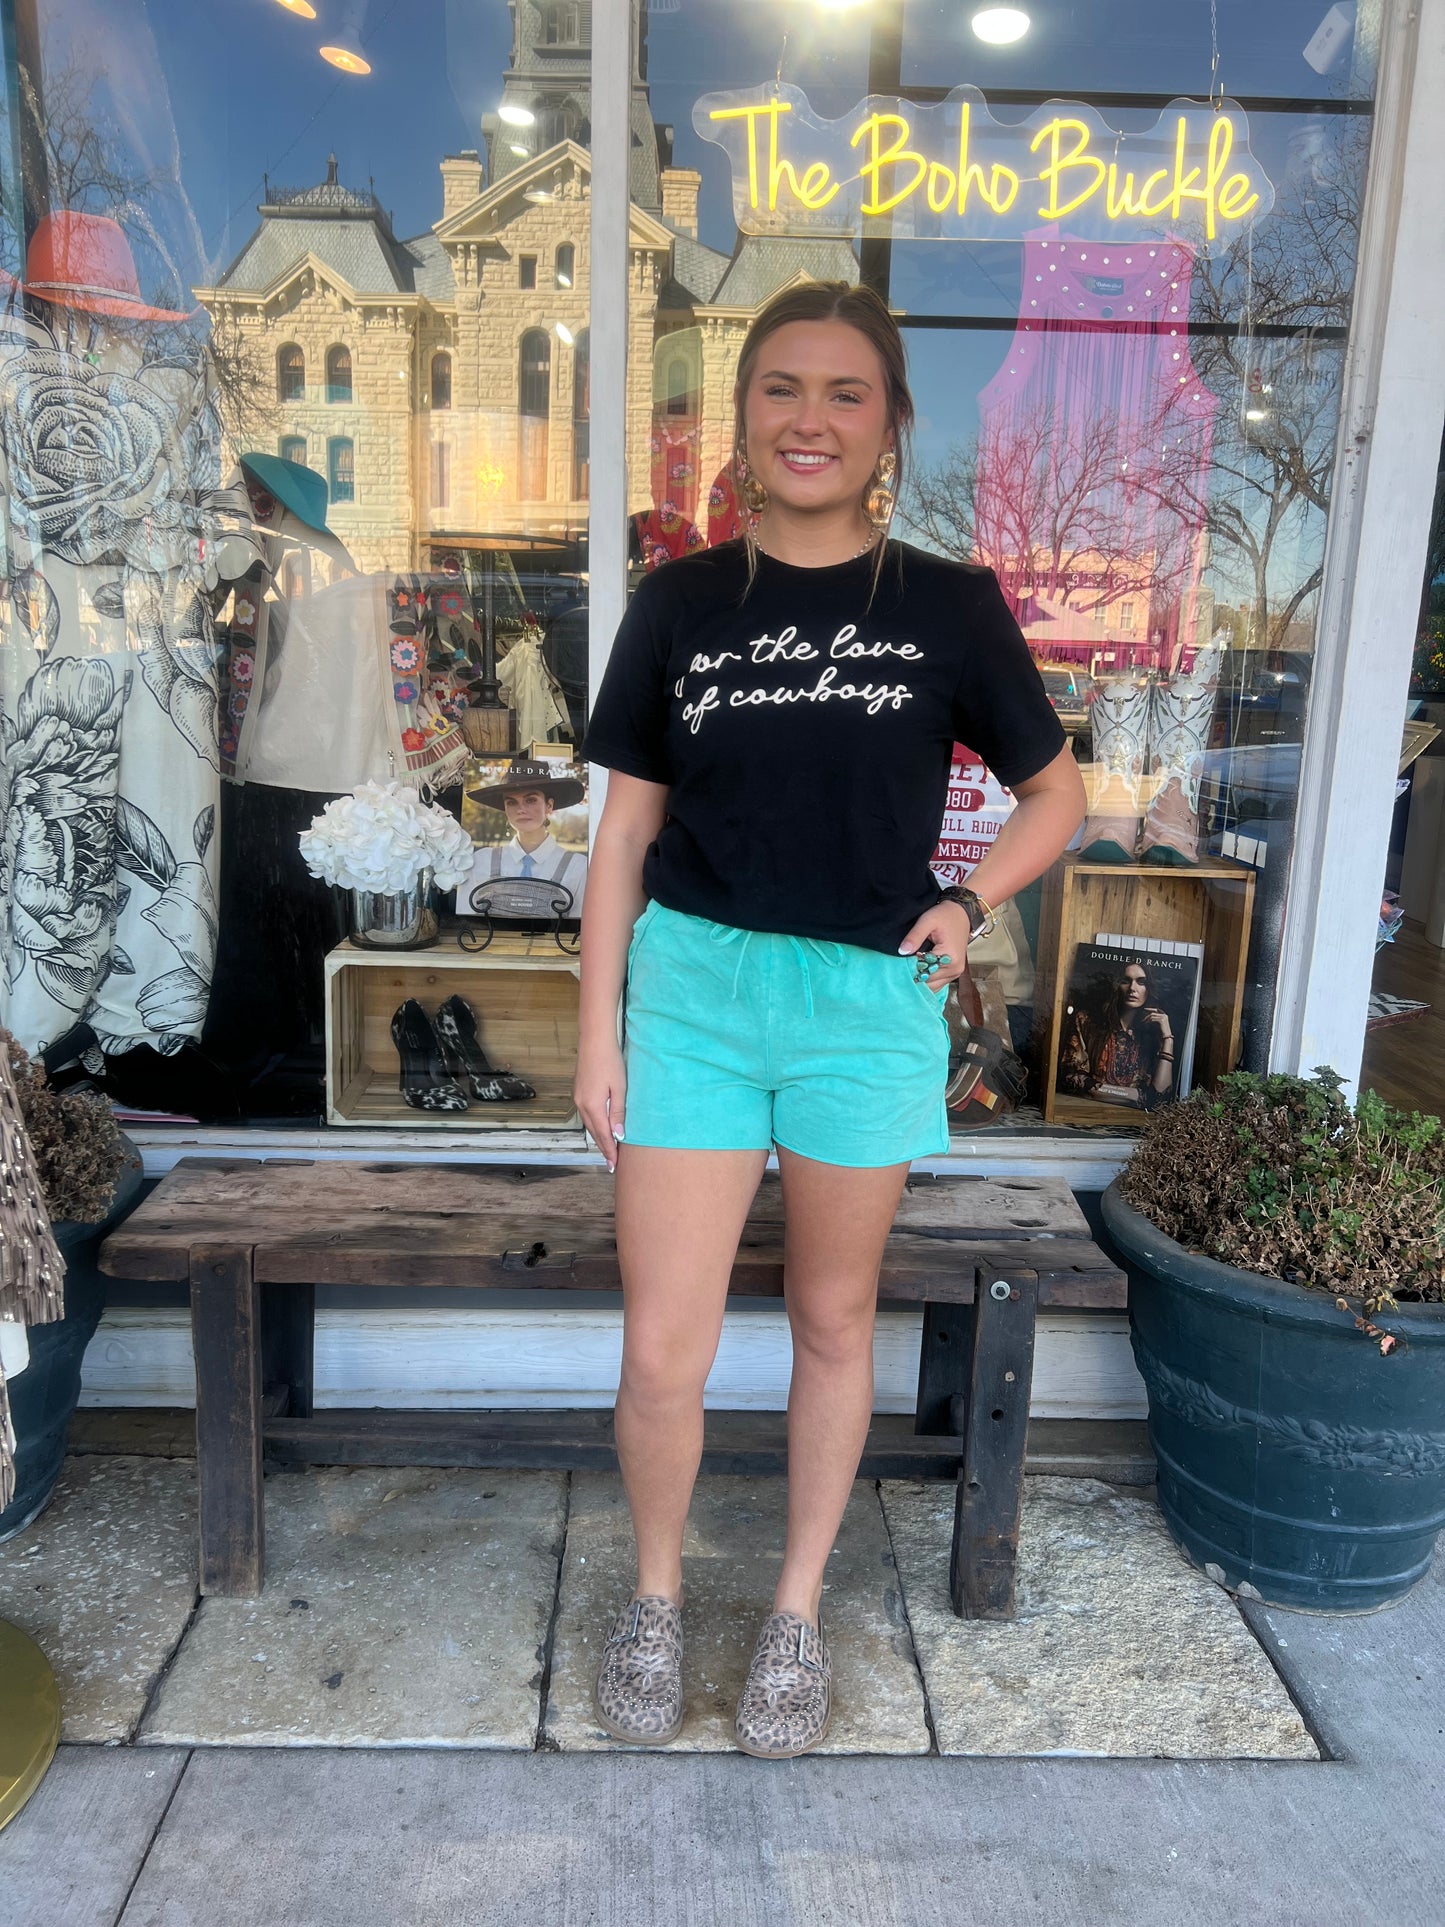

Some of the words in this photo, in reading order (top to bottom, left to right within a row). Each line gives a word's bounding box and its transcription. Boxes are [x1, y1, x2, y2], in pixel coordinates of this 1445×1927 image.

[710, 98, 840, 212] The
[850, 102, 1020, 217] Boho
[1030, 116, 1260, 240] Buckle
[749, 626, 819, 663] the
[829, 624, 924, 660] love
[682, 686, 720, 734] of
[729, 667, 913, 715] cowboys
[1091, 951, 1130, 963] DOUBLE
[1146, 959, 1182, 970] RANCH
